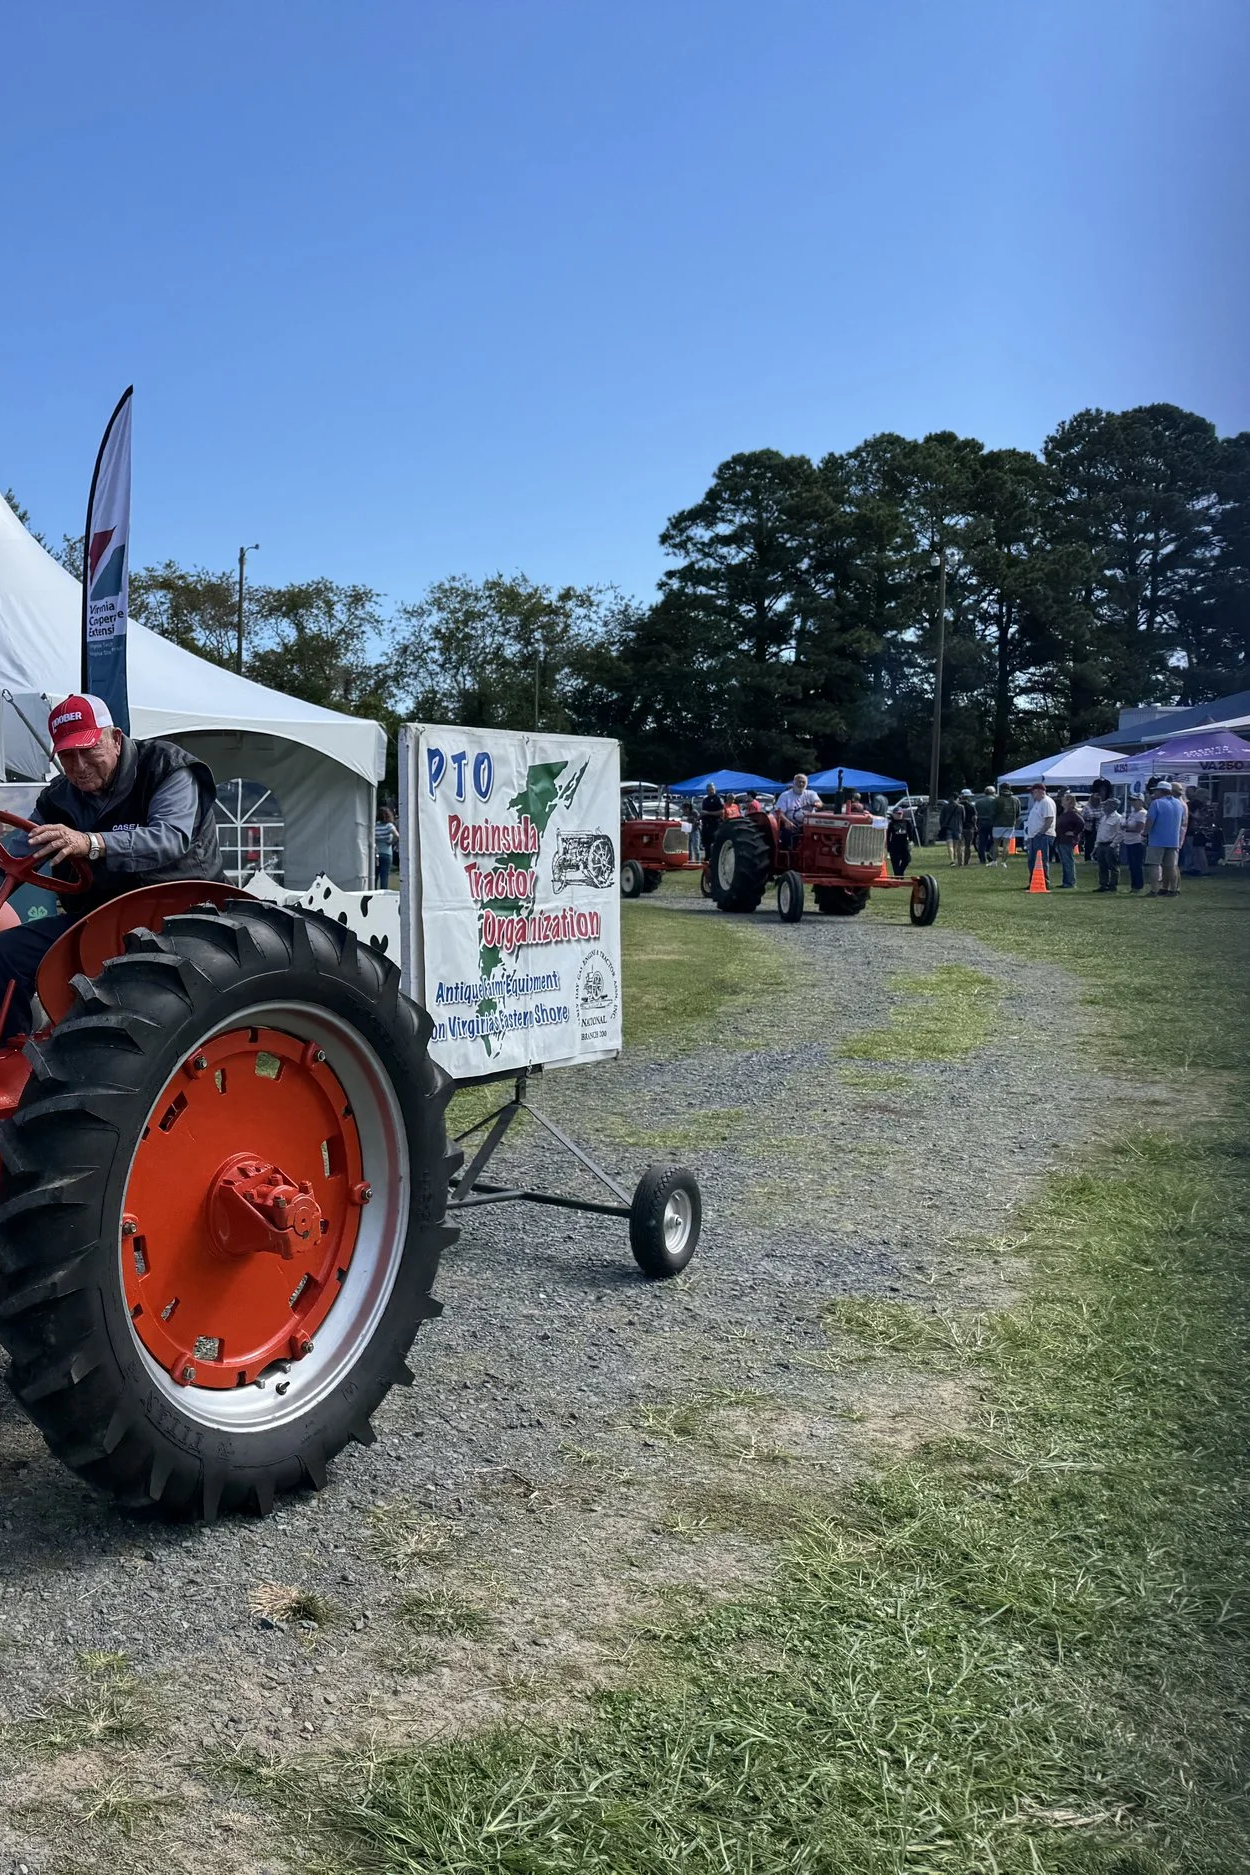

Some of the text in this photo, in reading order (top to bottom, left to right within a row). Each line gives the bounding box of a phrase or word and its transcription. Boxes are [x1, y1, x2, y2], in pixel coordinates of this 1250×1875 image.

[427, 748, 493, 801] PTO
[1199, 760, 1244, 770] VA250
[448, 814, 538, 854] Peninsula
[464, 862, 536, 898] Tractor
[482, 906, 600, 951] Organization
[435, 981, 483, 1006] Antique
[505, 970, 559, 998] Equipment
[432, 1023, 446, 1041] on
[535, 1002, 569, 1025] Shore
[581, 1015, 607, 1028] NATIONAL
[581, 1031, 598, 1041] BRANCH
